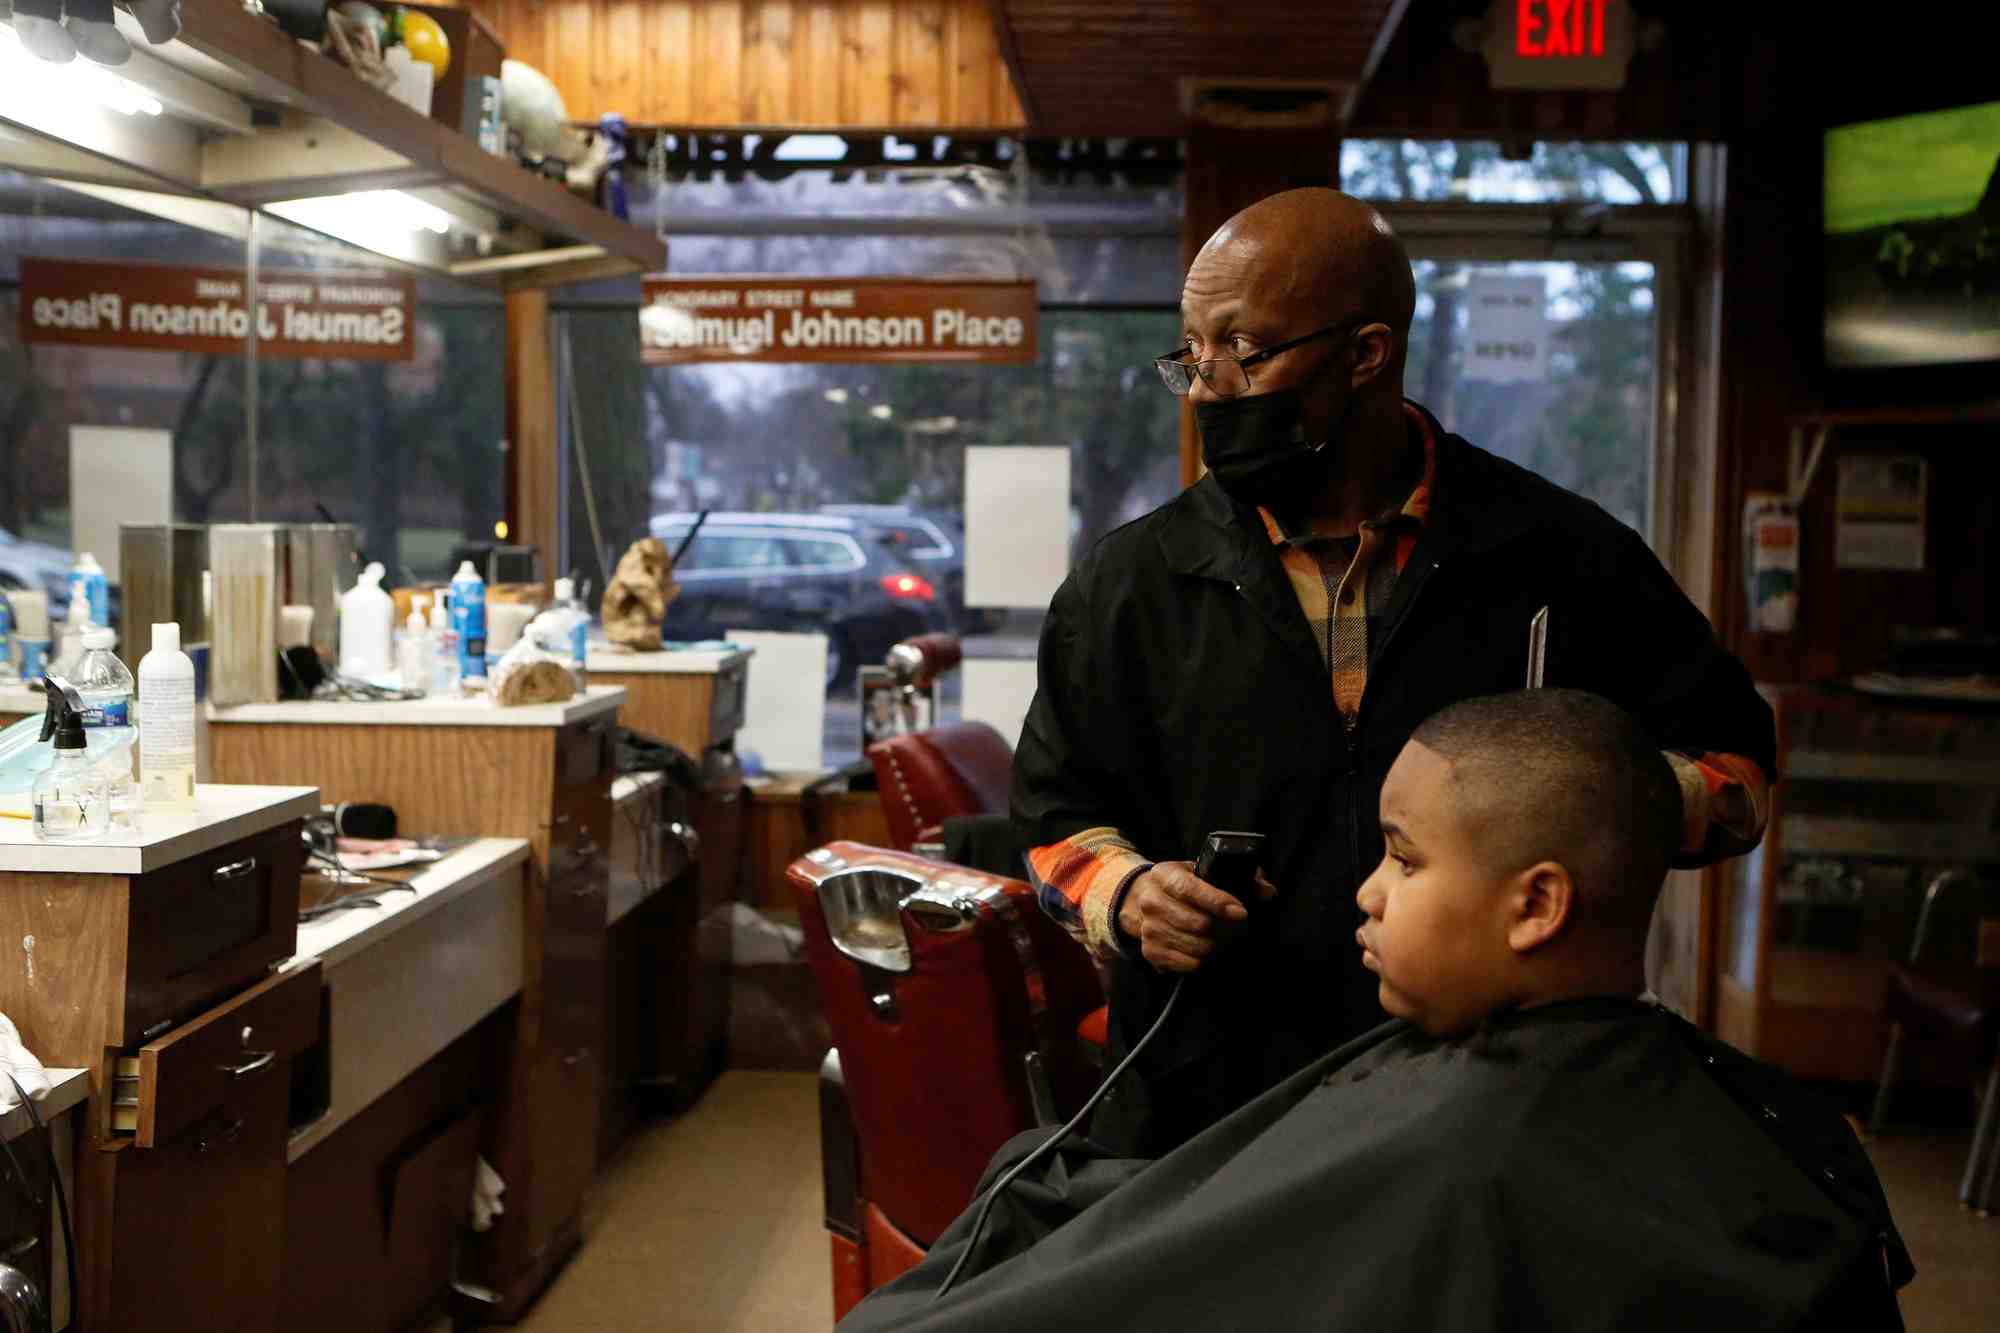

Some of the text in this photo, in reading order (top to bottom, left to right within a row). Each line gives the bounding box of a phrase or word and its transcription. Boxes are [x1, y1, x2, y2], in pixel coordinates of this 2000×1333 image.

[1516, 0, 1606, 58] EXIT
[781, 309, 924, 346] Johnson
[932, 308, 1024, 345] Place
